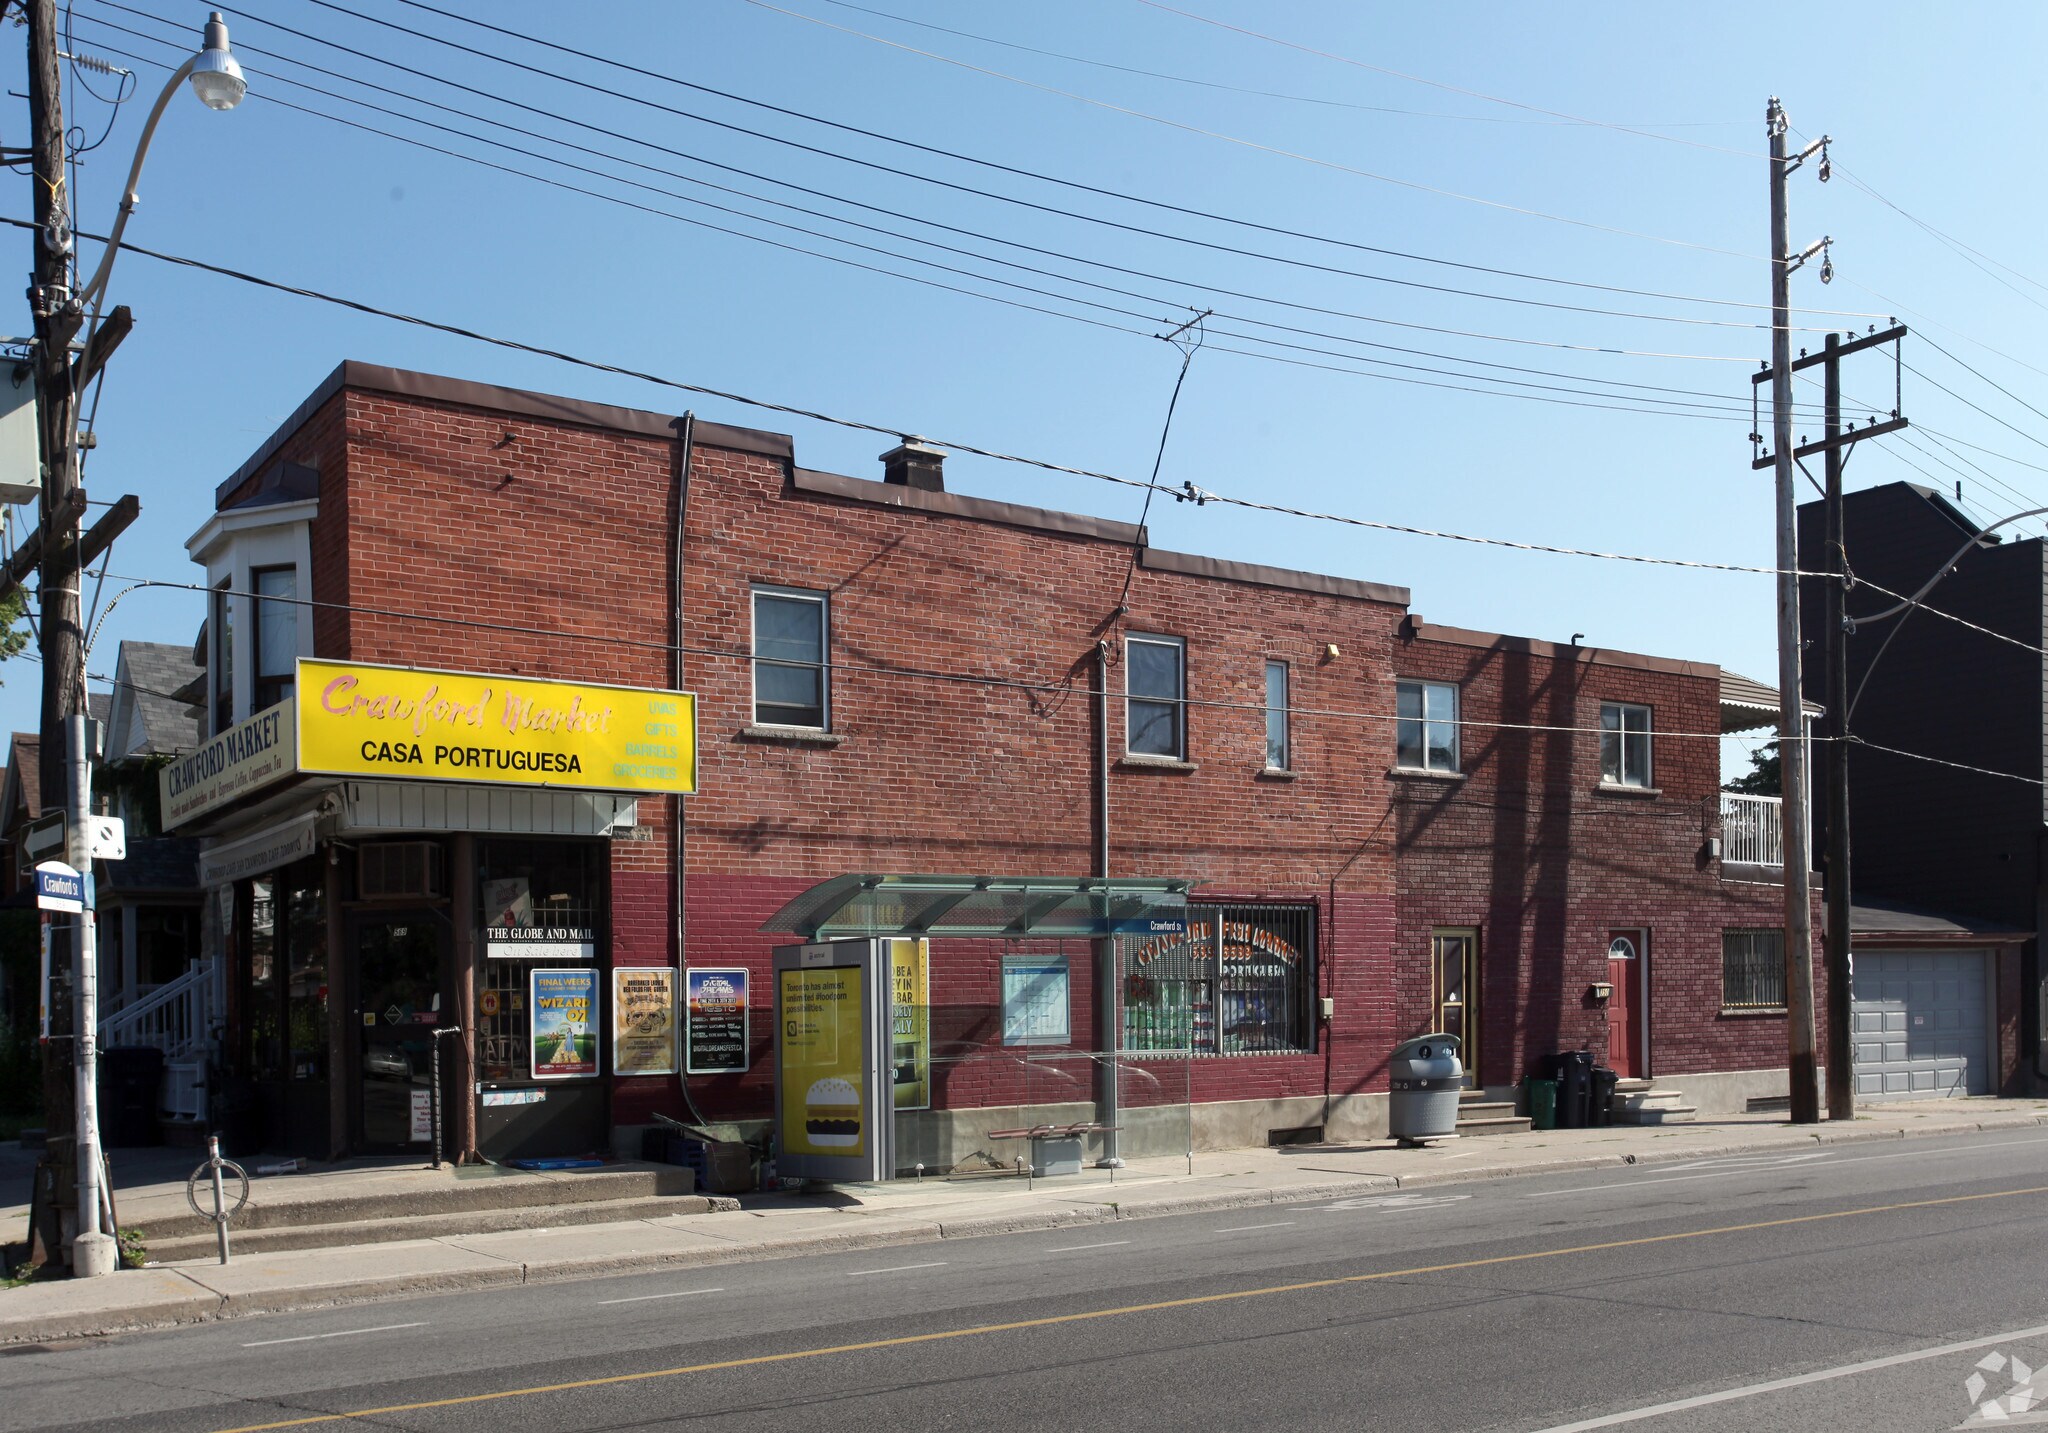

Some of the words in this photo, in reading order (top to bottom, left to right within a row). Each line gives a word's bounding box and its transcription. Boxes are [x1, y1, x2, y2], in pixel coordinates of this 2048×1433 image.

[320, 674, 493, 737] Crawford
[501, 690, 613, 736] Market
[648, 702, 677, 716] UVAS
[645, 723, 678, 737] GIFTS
[168, 740, 225, 798] CRAWFORD
[226, 710, 280, 768] MARKET
[361, 740, 423, 764] CASA
[434, 745, 582, 774] PORTUGUESA
[625, 743, 678, 759] BARRELS
[273, 754, 282, 771] Tea
[612, 763, 678, 779] GROCERIES
[44, 874, 73, 895] Crawford
[72, 882, 79, 896] St
[1150, 920, 1176, 931] Crawford
[487, 928, 509, 939] THE
[511, 928, 544, 939] GLOBE
[546, 928, 567, 939] AND
[569, 928, 594, 940] MAIL
[503, 945, 521, 956] On
[524, 945, 550, 956] Sale
[552, 945, 578, 956] here
[896, 966, 905, 977] BE
[906, 965, 912, 977] A
[538, 978, 562, 986] FINAL
[563, 977, 592, 986] WEEKS
[702, 979, 731, 987] DIGITAL
[786, 982, 810, 993] Toronto
[810, 982, 821, 991] has
[822, 981, 845, 990] almost
[903, 978, 912, 990] IN
[699, 986, 735, 994] DREAMS
[538, 997, 591, 1009] WIZARD
[786, 993, 815, 1003] unlimited
[815, 991, 848, 1002] #foodporn
[896, 992, 915, 1004] BAR.
[566, 1008, 590, 1023] OZ
[482, 1039, 530, 1059] ATM
